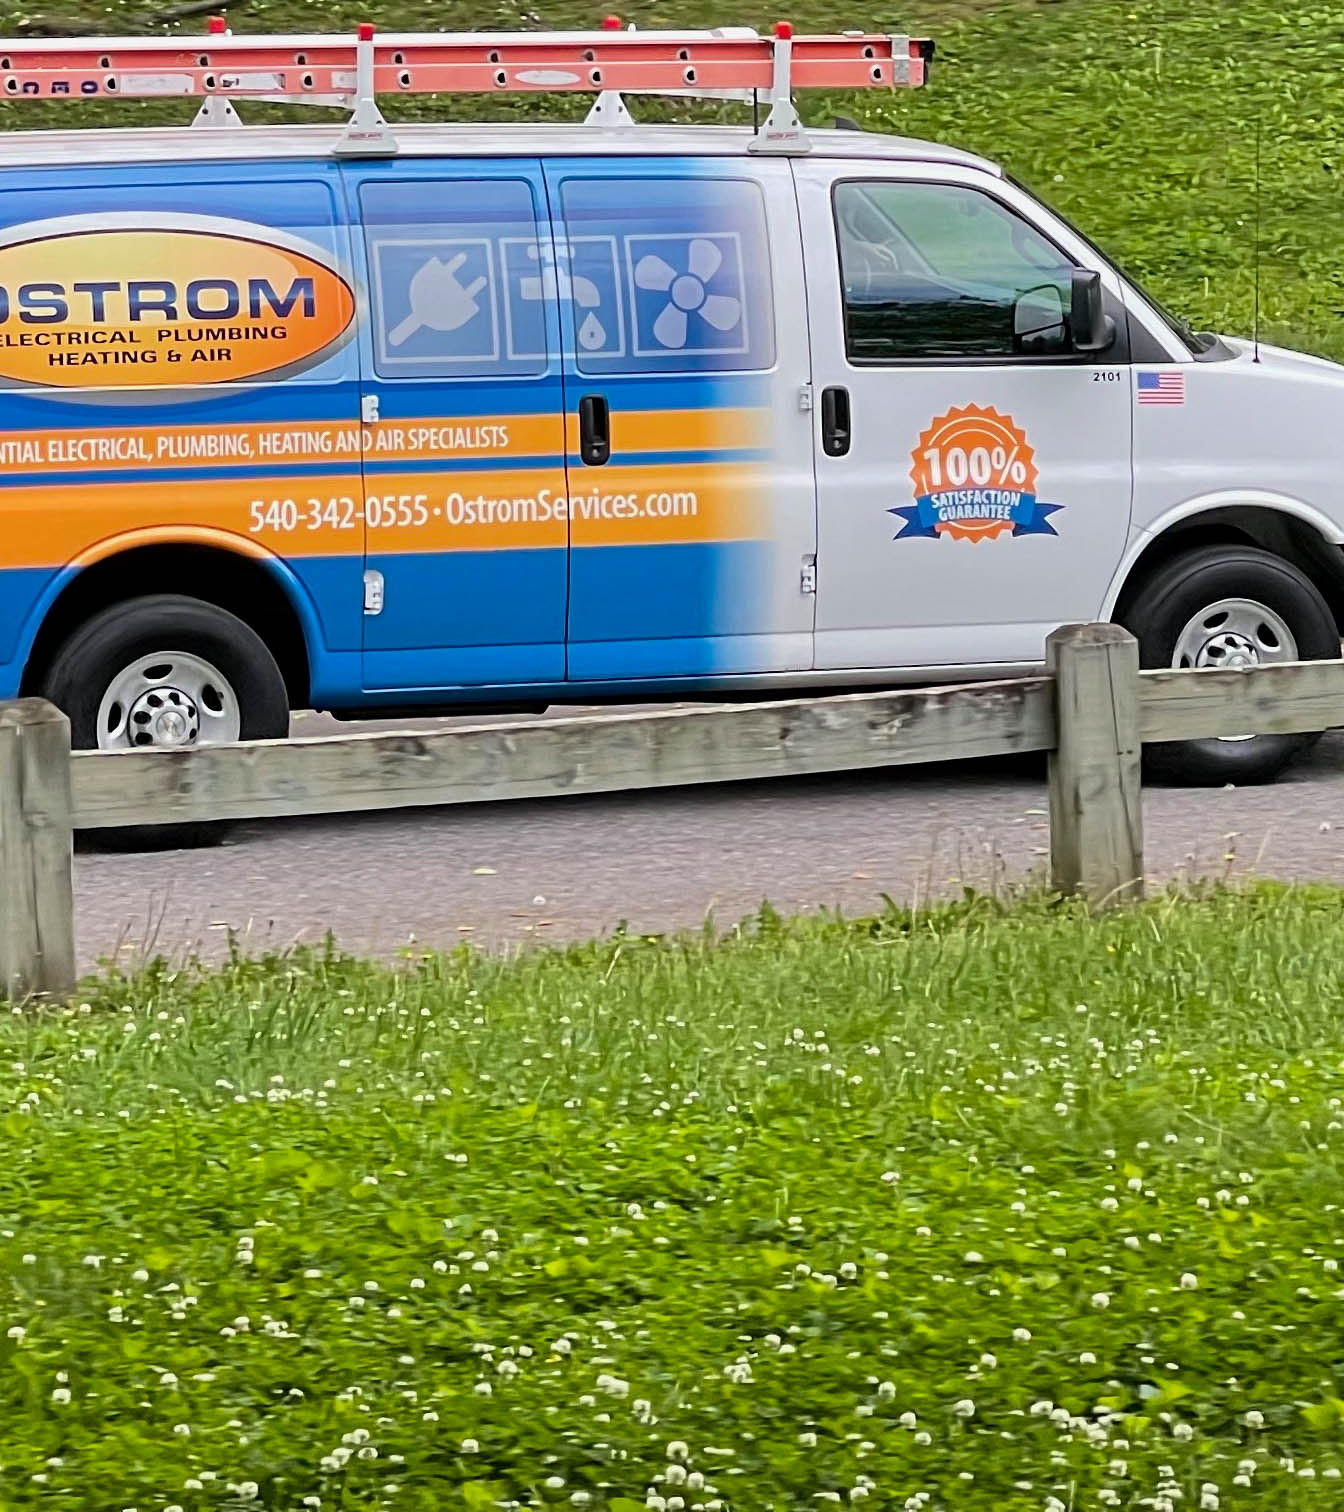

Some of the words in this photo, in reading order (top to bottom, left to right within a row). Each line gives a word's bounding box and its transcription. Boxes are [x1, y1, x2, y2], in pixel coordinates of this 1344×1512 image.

[157, 326, 288, 343] PLUMBING
[48, 350, 157, 366] HEATING
[167, 349, 182, 363] &
[190, 347, 232, 363] AIR
[1092, 371, 1122, 383] 2101
[48, 436, 153, 463] ELECTRICAL,
[157, 433, 255, 459] PLUMBING,
[258, 431, 332, 455] HEATING
[335, 429, 372, 453] AND
[376, 428, 406, 451] AIR
[407, 425, 509, 450] SPECIALISTS
[923, 446, 1027, 486] 100%
[930, 490, 1021, 509] SATISFACTION
[249, 495, 429, 532] 540-342-0555
[446, 487, 697, 525] OstromServices.com
[938, 504, 1011, 522] GUARANTEE
